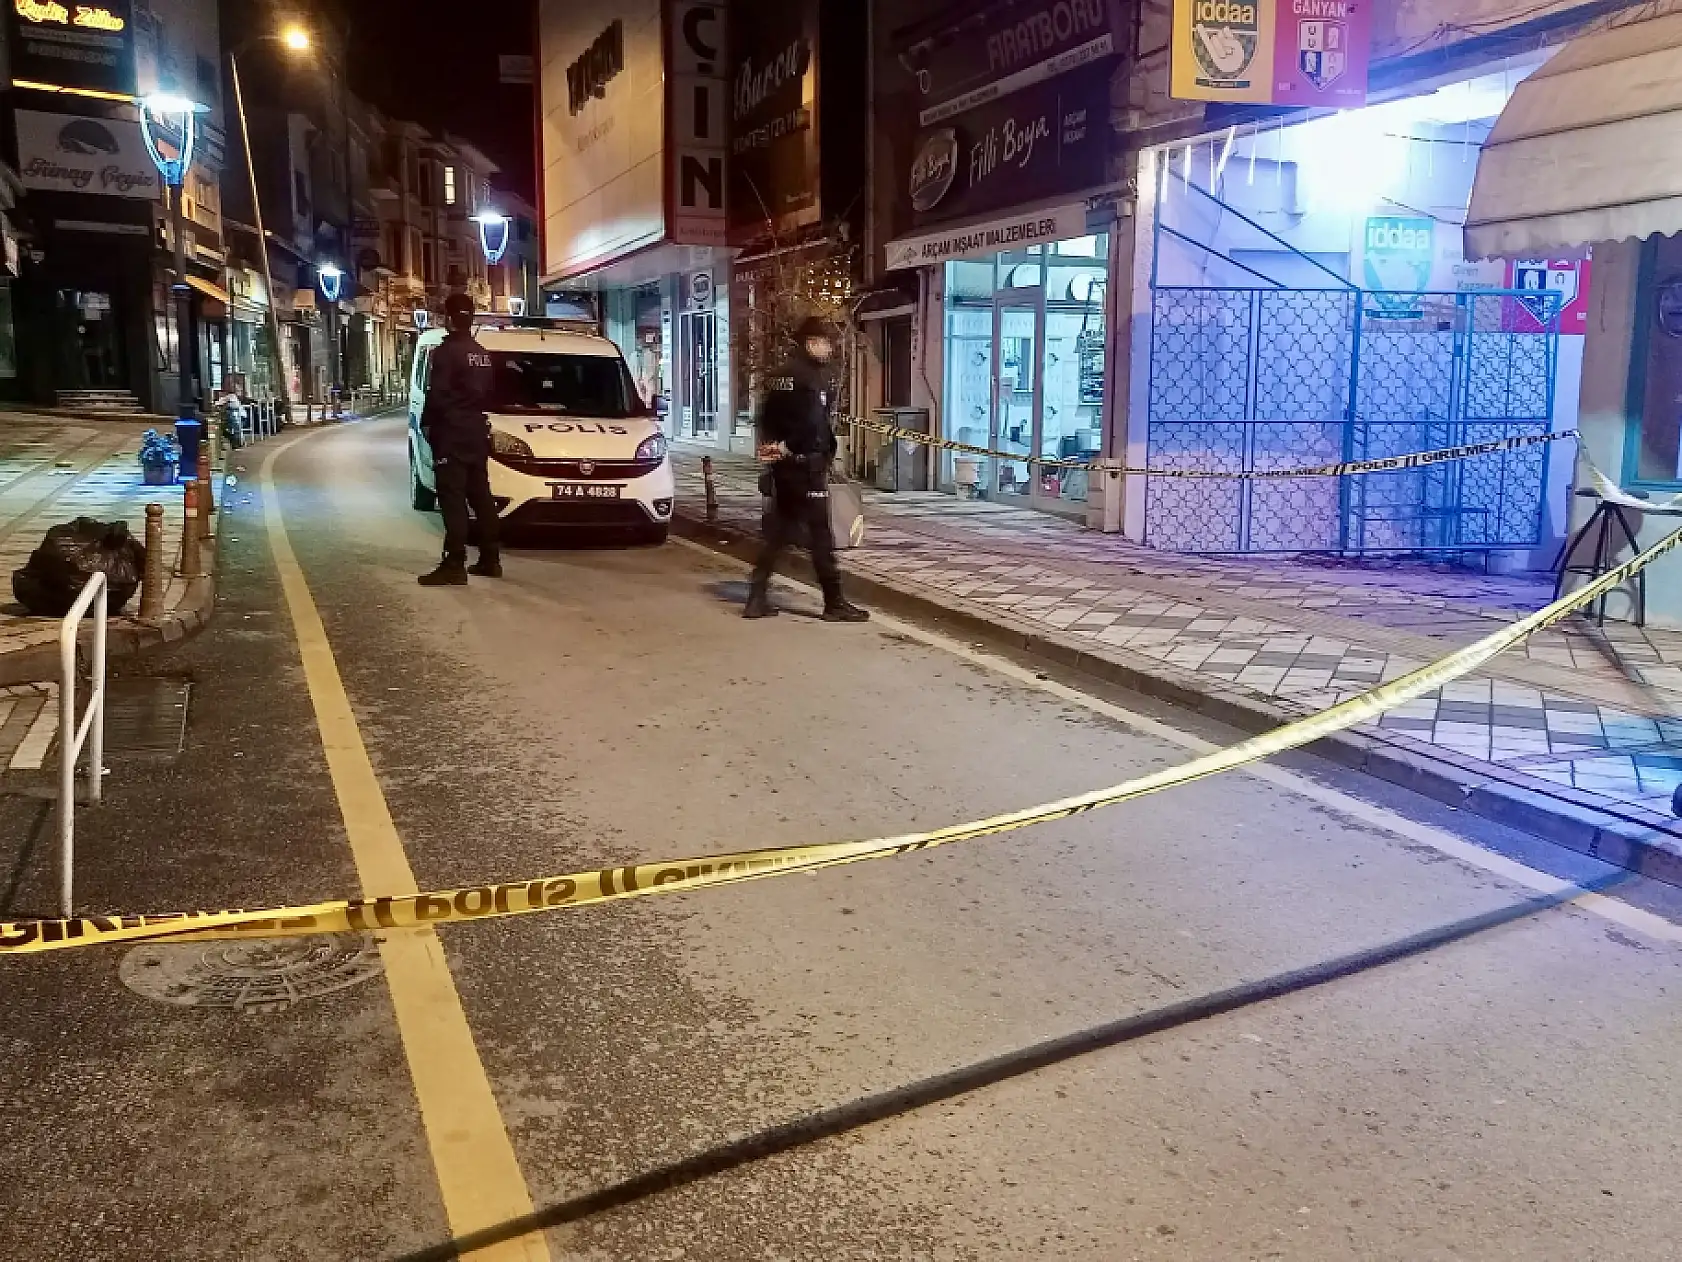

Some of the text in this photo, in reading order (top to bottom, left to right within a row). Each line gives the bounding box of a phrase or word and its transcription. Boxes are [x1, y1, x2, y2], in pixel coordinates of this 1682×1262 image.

[1195, 0, 1254, 24] iddaa
[1293, 0, 1346, 18] GANYAN
[1002, 115, 1050, 169] Boya
[1367, 222, 1431, 249] iddaa
